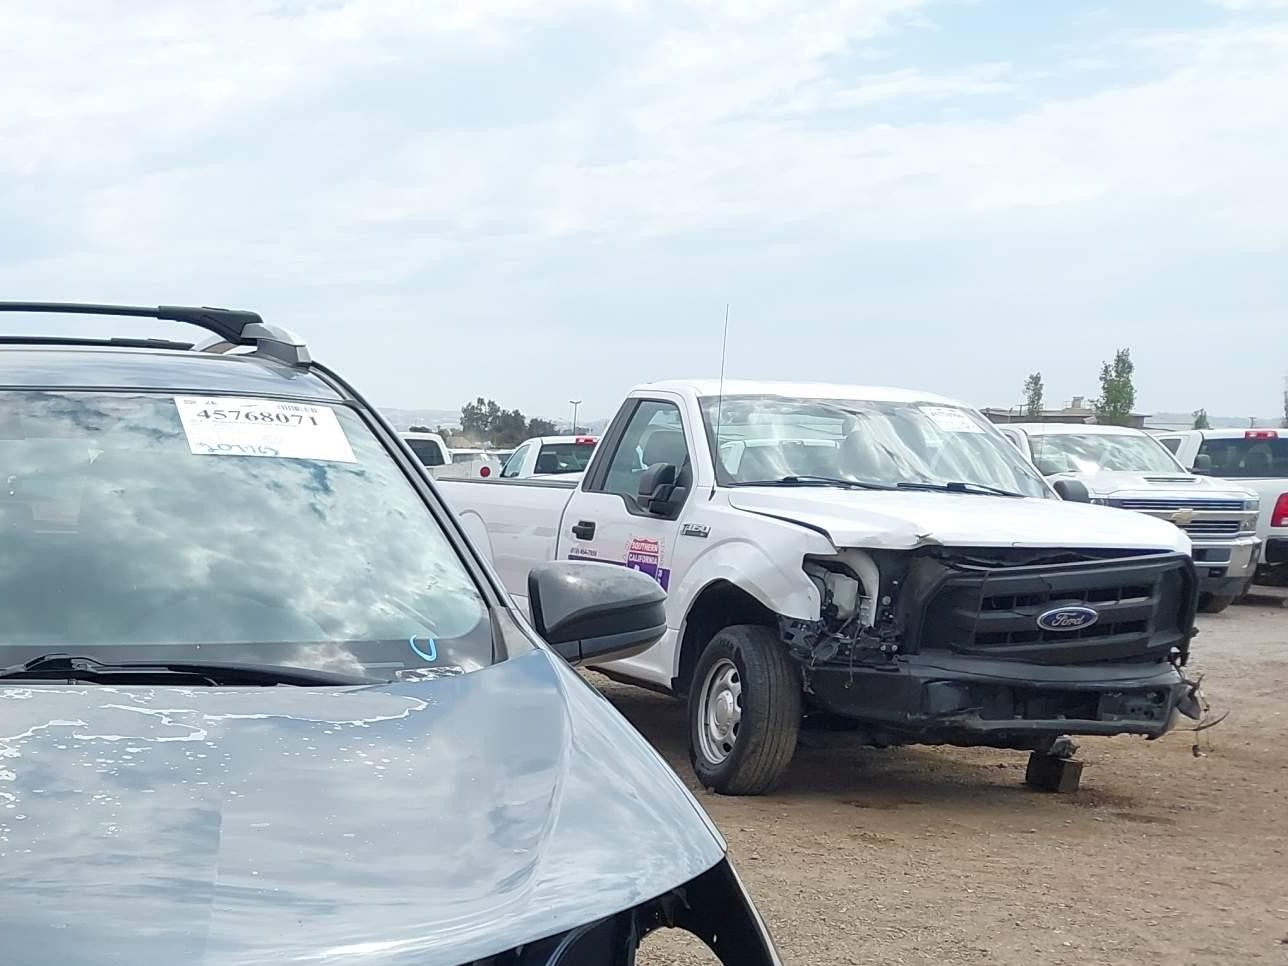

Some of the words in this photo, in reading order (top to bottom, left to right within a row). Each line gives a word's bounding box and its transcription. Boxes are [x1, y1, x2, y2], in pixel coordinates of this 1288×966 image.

[196, 409, 318, 426] 45768071
[631, 542, 658, 552] SOUTHERN
[629, 553, 658, 564] CALIFORNIA
[1051, 612, 1085, 626] Ford
